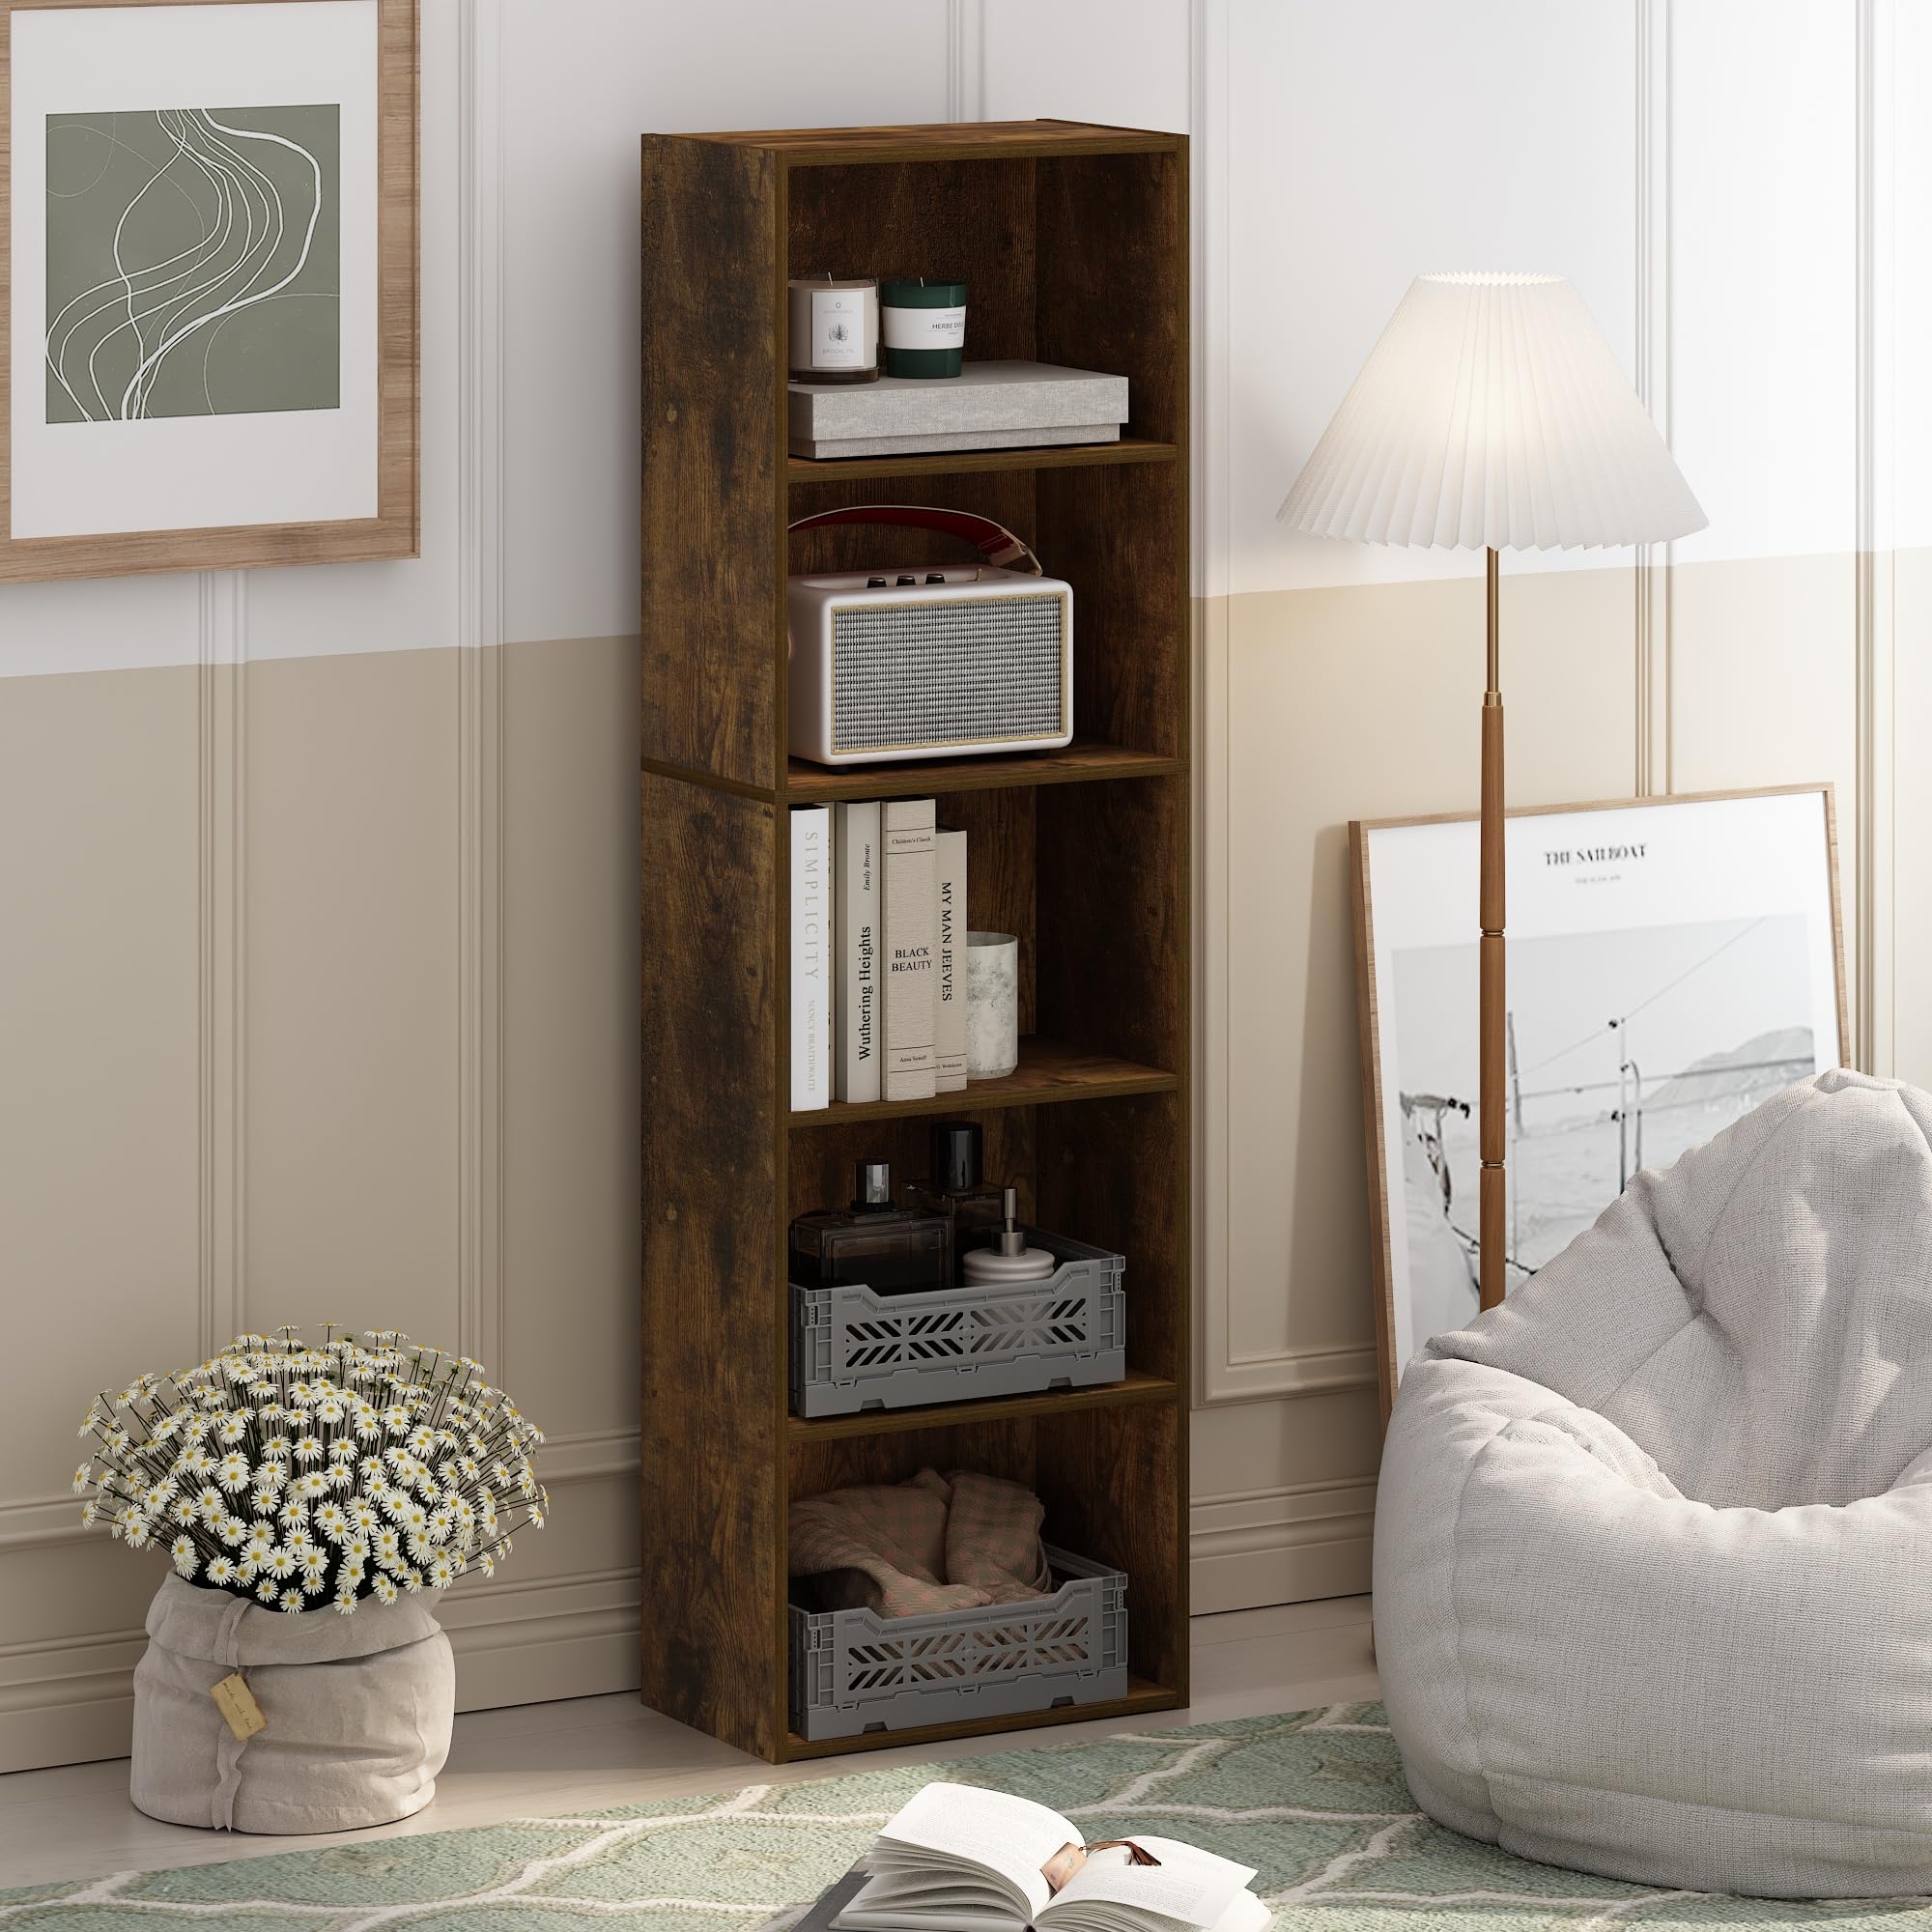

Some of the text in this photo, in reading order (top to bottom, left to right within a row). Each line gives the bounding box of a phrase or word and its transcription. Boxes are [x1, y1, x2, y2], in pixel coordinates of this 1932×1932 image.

[1544, 844, 1646, 866] THE SAILBOAT
[863, 869, 871, 891] Emily
[805, 832, 819, 979] SIMPLICITY
[895, 947, 929, 958] BLACK
[942, 882, 952, 1002] MY MAN JEEVES
[892, 959, 932, 972] BEAUTY
[858, 926, 873, 1061] Wuthering Heights
